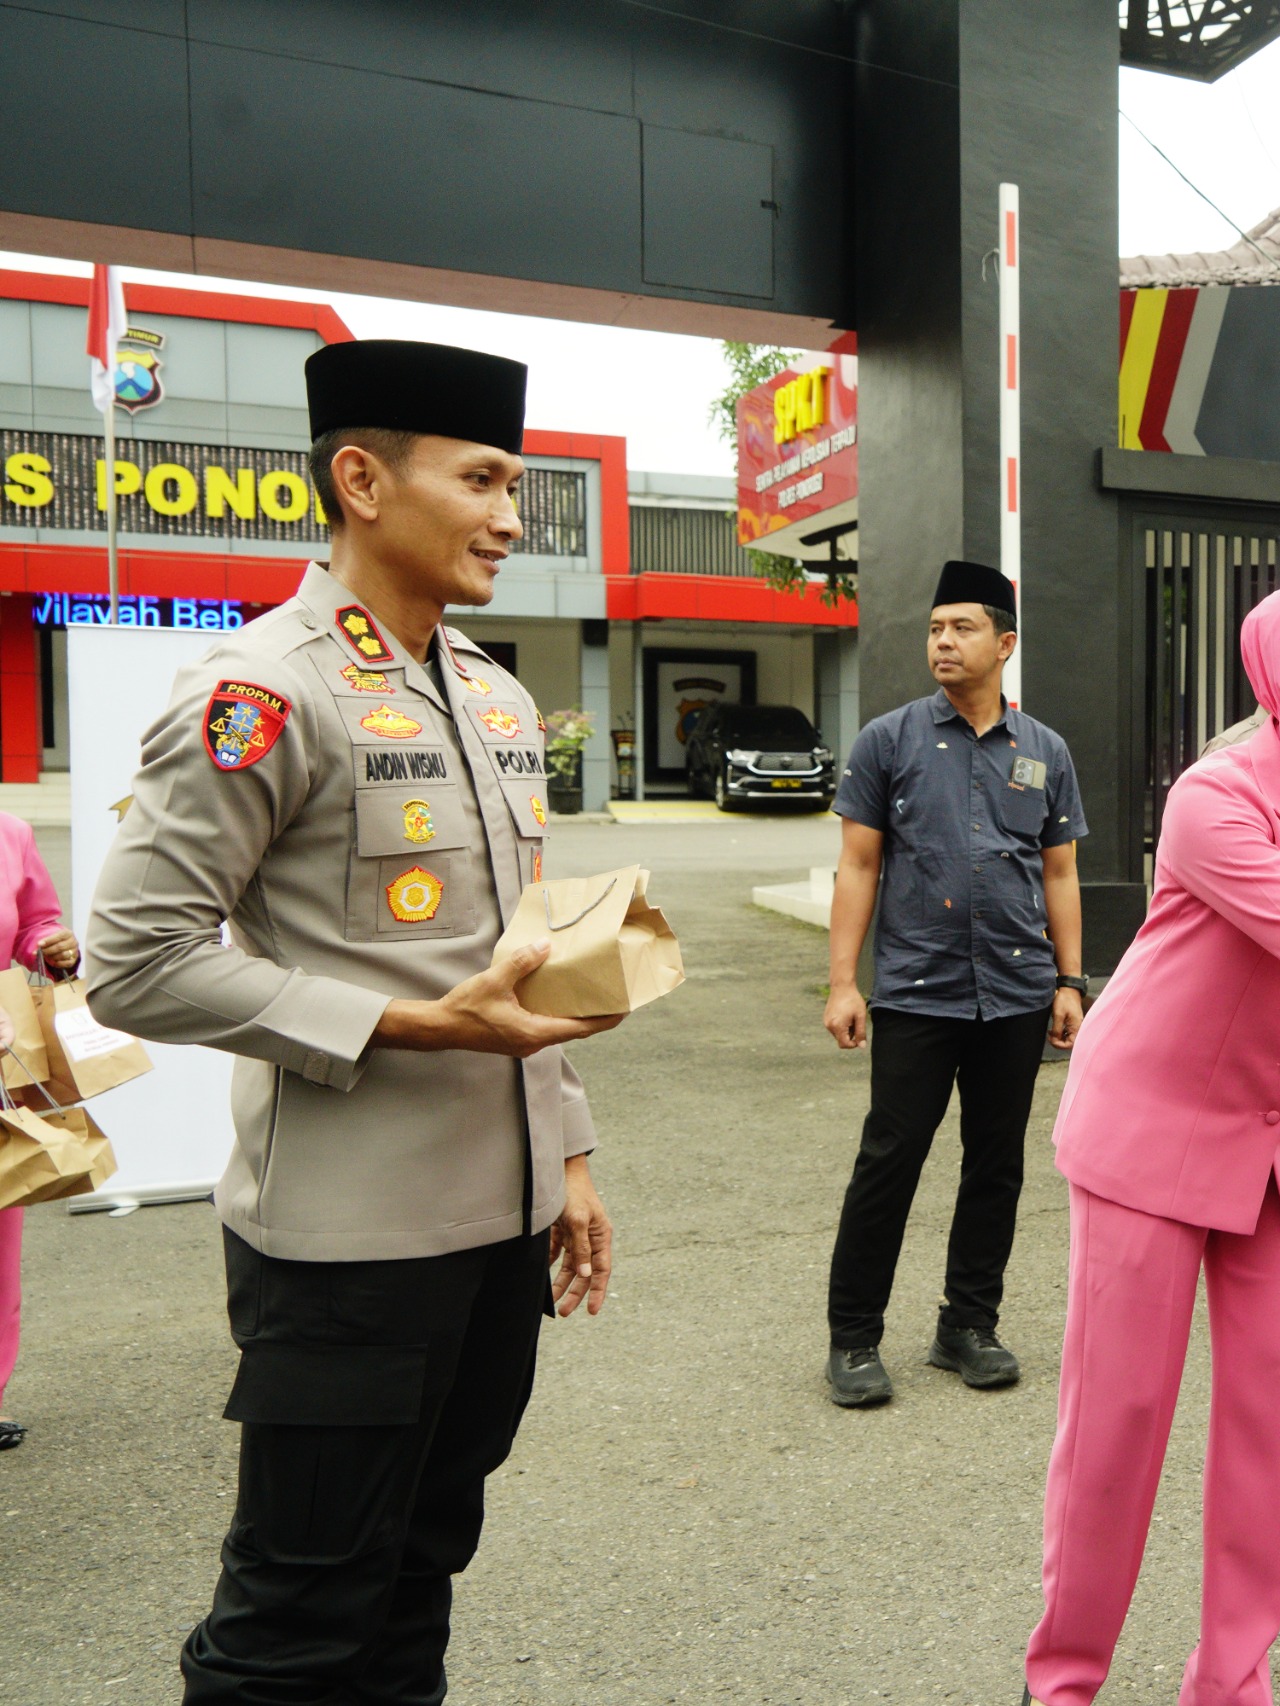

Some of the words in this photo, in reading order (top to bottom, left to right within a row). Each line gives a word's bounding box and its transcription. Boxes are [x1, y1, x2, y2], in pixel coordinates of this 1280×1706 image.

[96, 459, 332, 525] PONO
[227, 683, 282, 711] PROPAM
[366, 752, 408, 782] ANDIN
[406, 752, 447, 780] WISNU
[499, 750, 545, 776] POLRI
